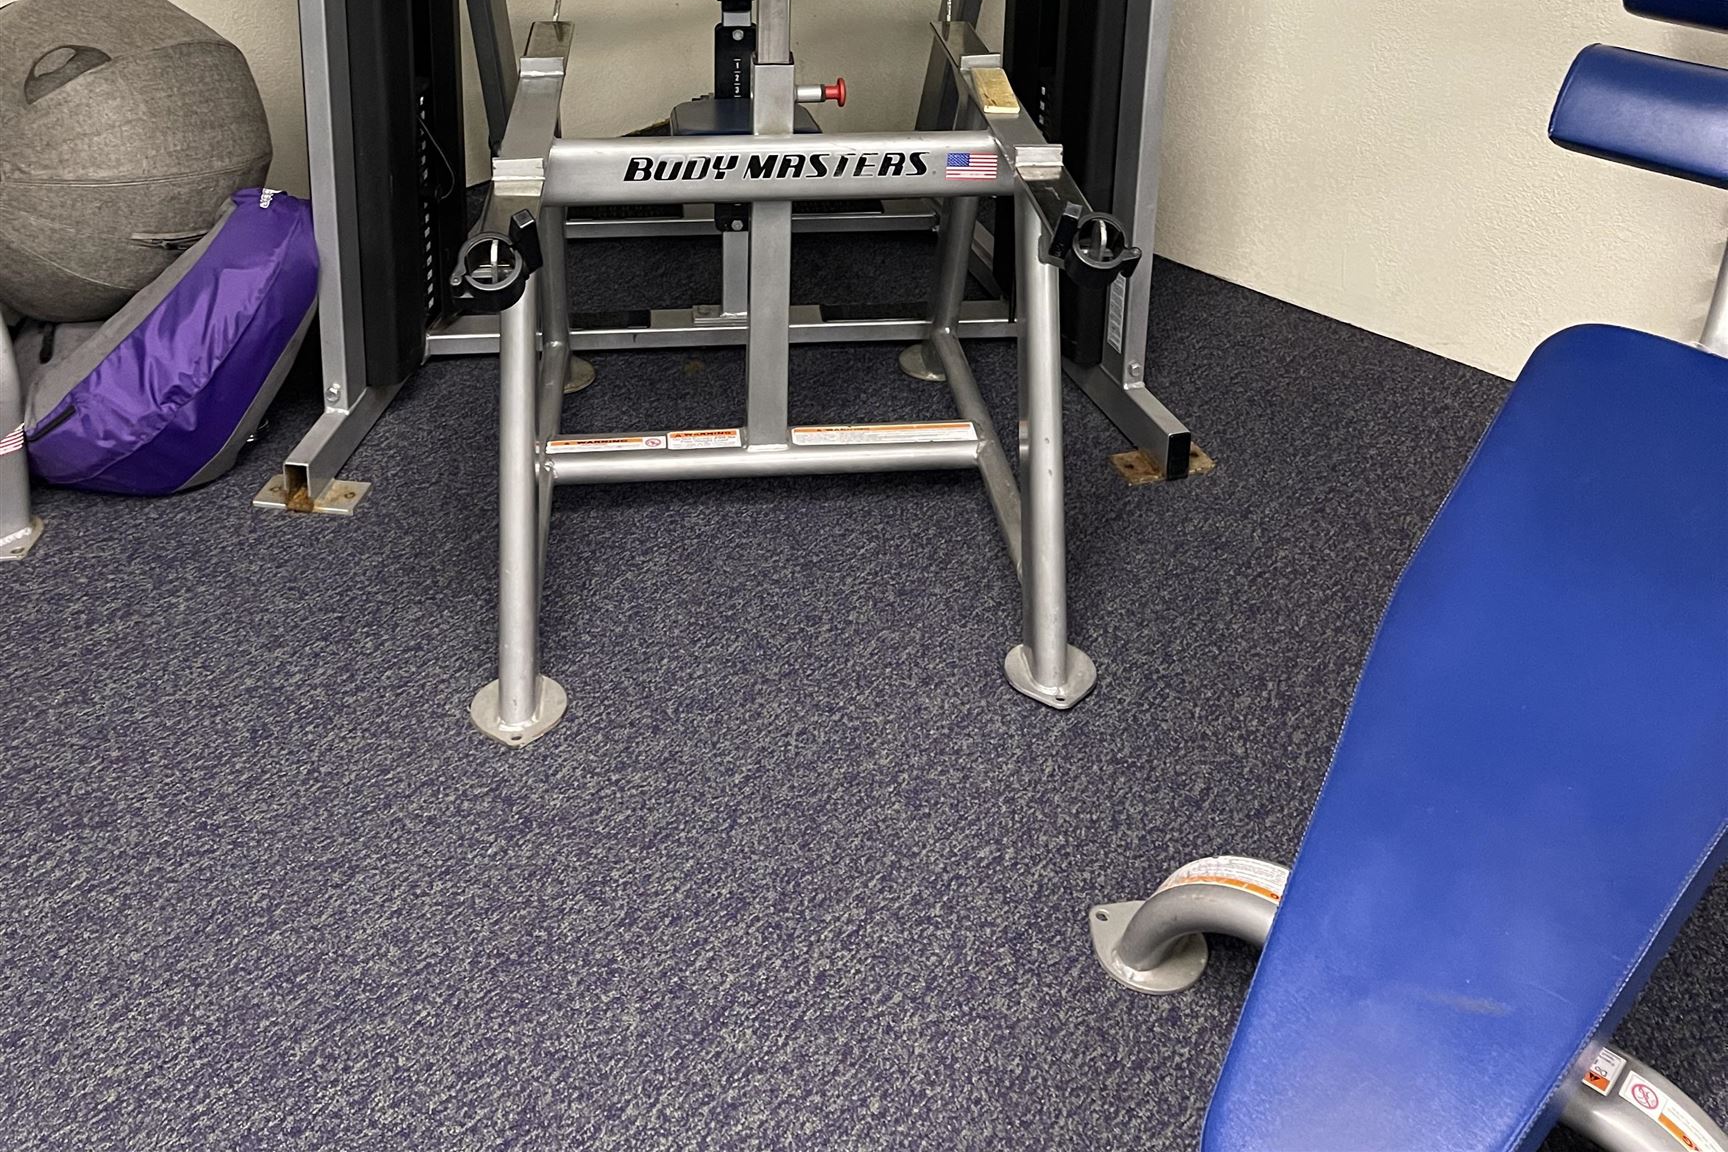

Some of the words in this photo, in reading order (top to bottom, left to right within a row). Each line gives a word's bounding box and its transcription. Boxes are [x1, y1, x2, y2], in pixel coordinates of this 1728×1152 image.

[734, 74, 740, 82] 2
[623, 155, 739, 182] BODY
[743, 151, 929, 179] MASTERS
